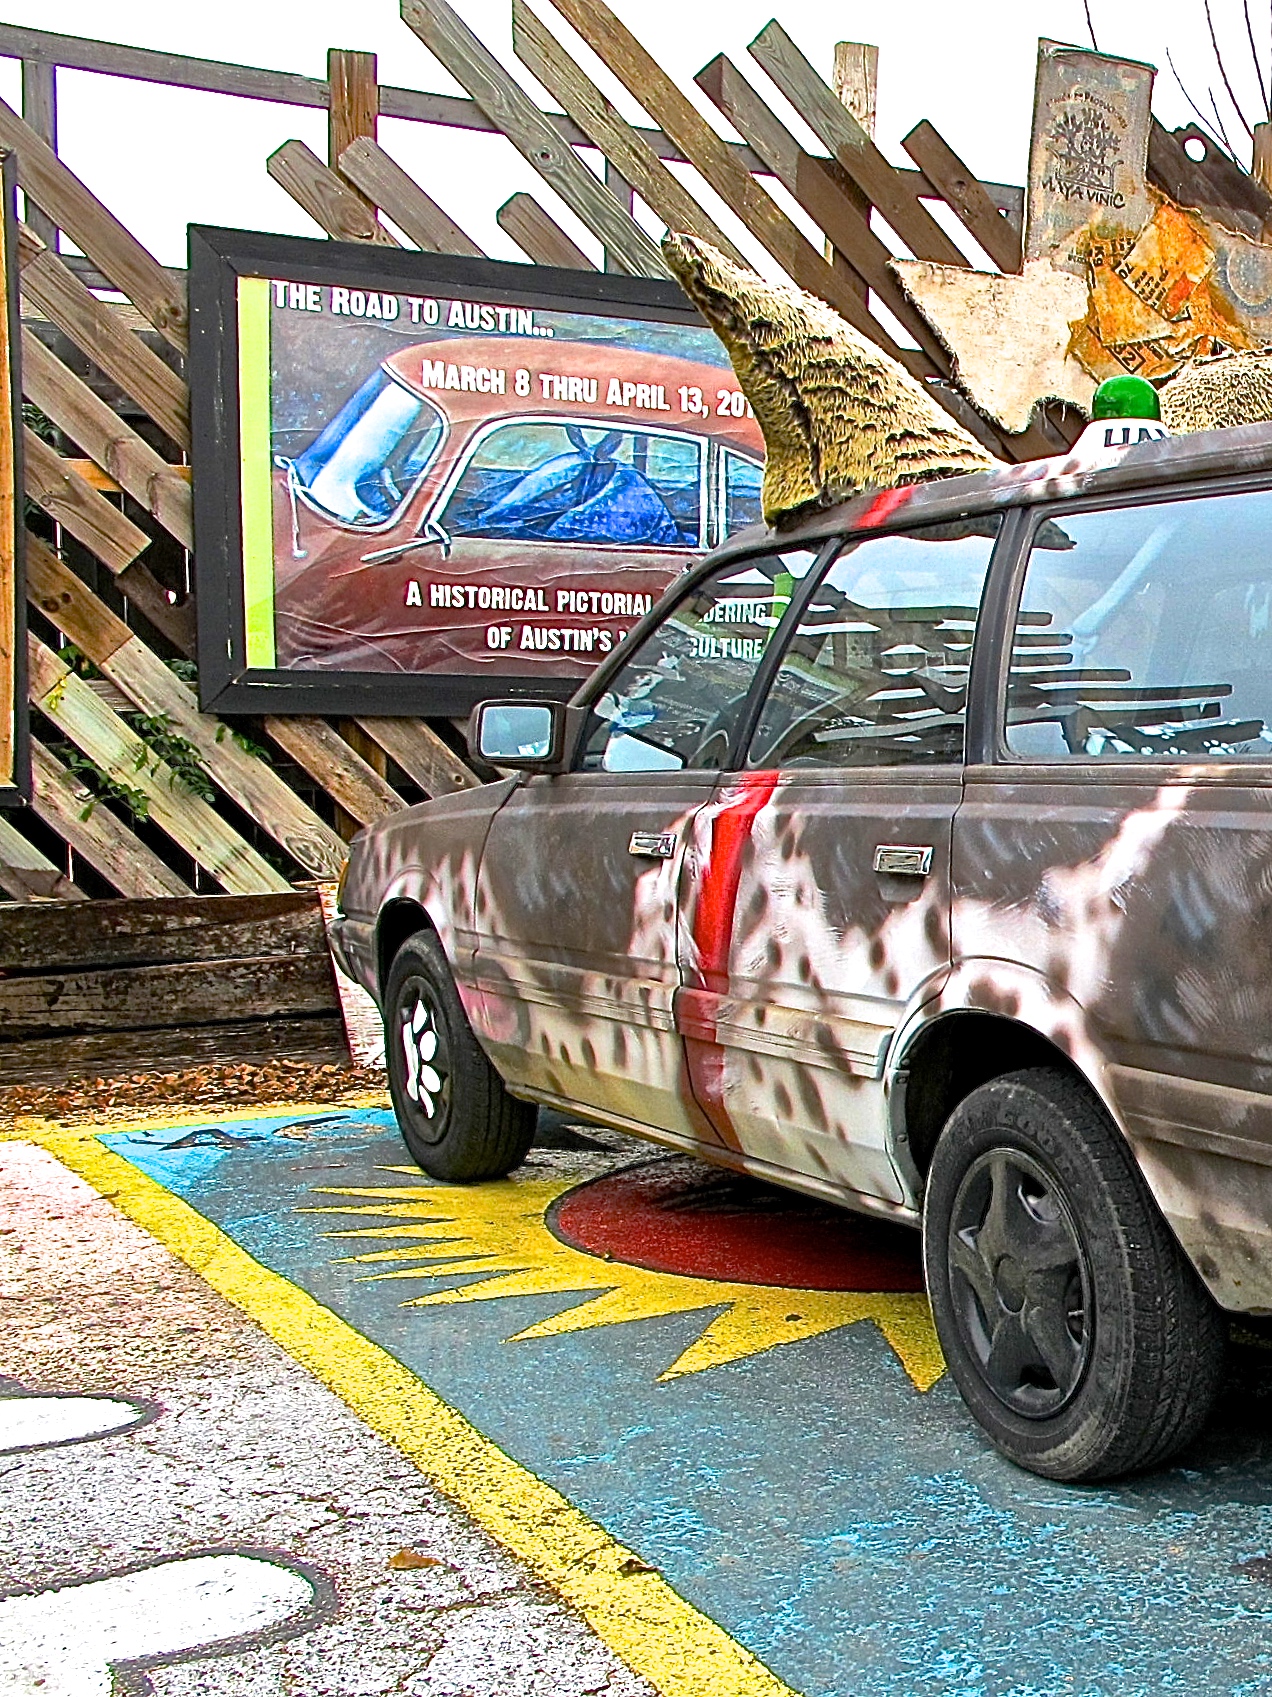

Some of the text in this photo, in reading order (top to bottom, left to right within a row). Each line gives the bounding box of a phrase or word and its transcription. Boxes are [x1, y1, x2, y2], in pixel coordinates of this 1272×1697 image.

[1086, 189, 1126, 209] VINIC
[1118, 262, 1135, 280] 70
[271, 279, 555, 338] THE ROAD TO AUSTIN...
[422, 359, 506, 395] MARCH
[514, 368, 531, 397] 8
[539, 372, 598, 404] THRU
[606, 377, 671, 411] APRIL
[677, 385, 710, 419] 13,
[405, 581, 422, 607] A
[429, 584, 549, 612] HISTORICAL
[698, 602, 767, 624] DERING
[487, 626, 513, 649] OF
[519, 624, 612, 652] AUSTIN'S
